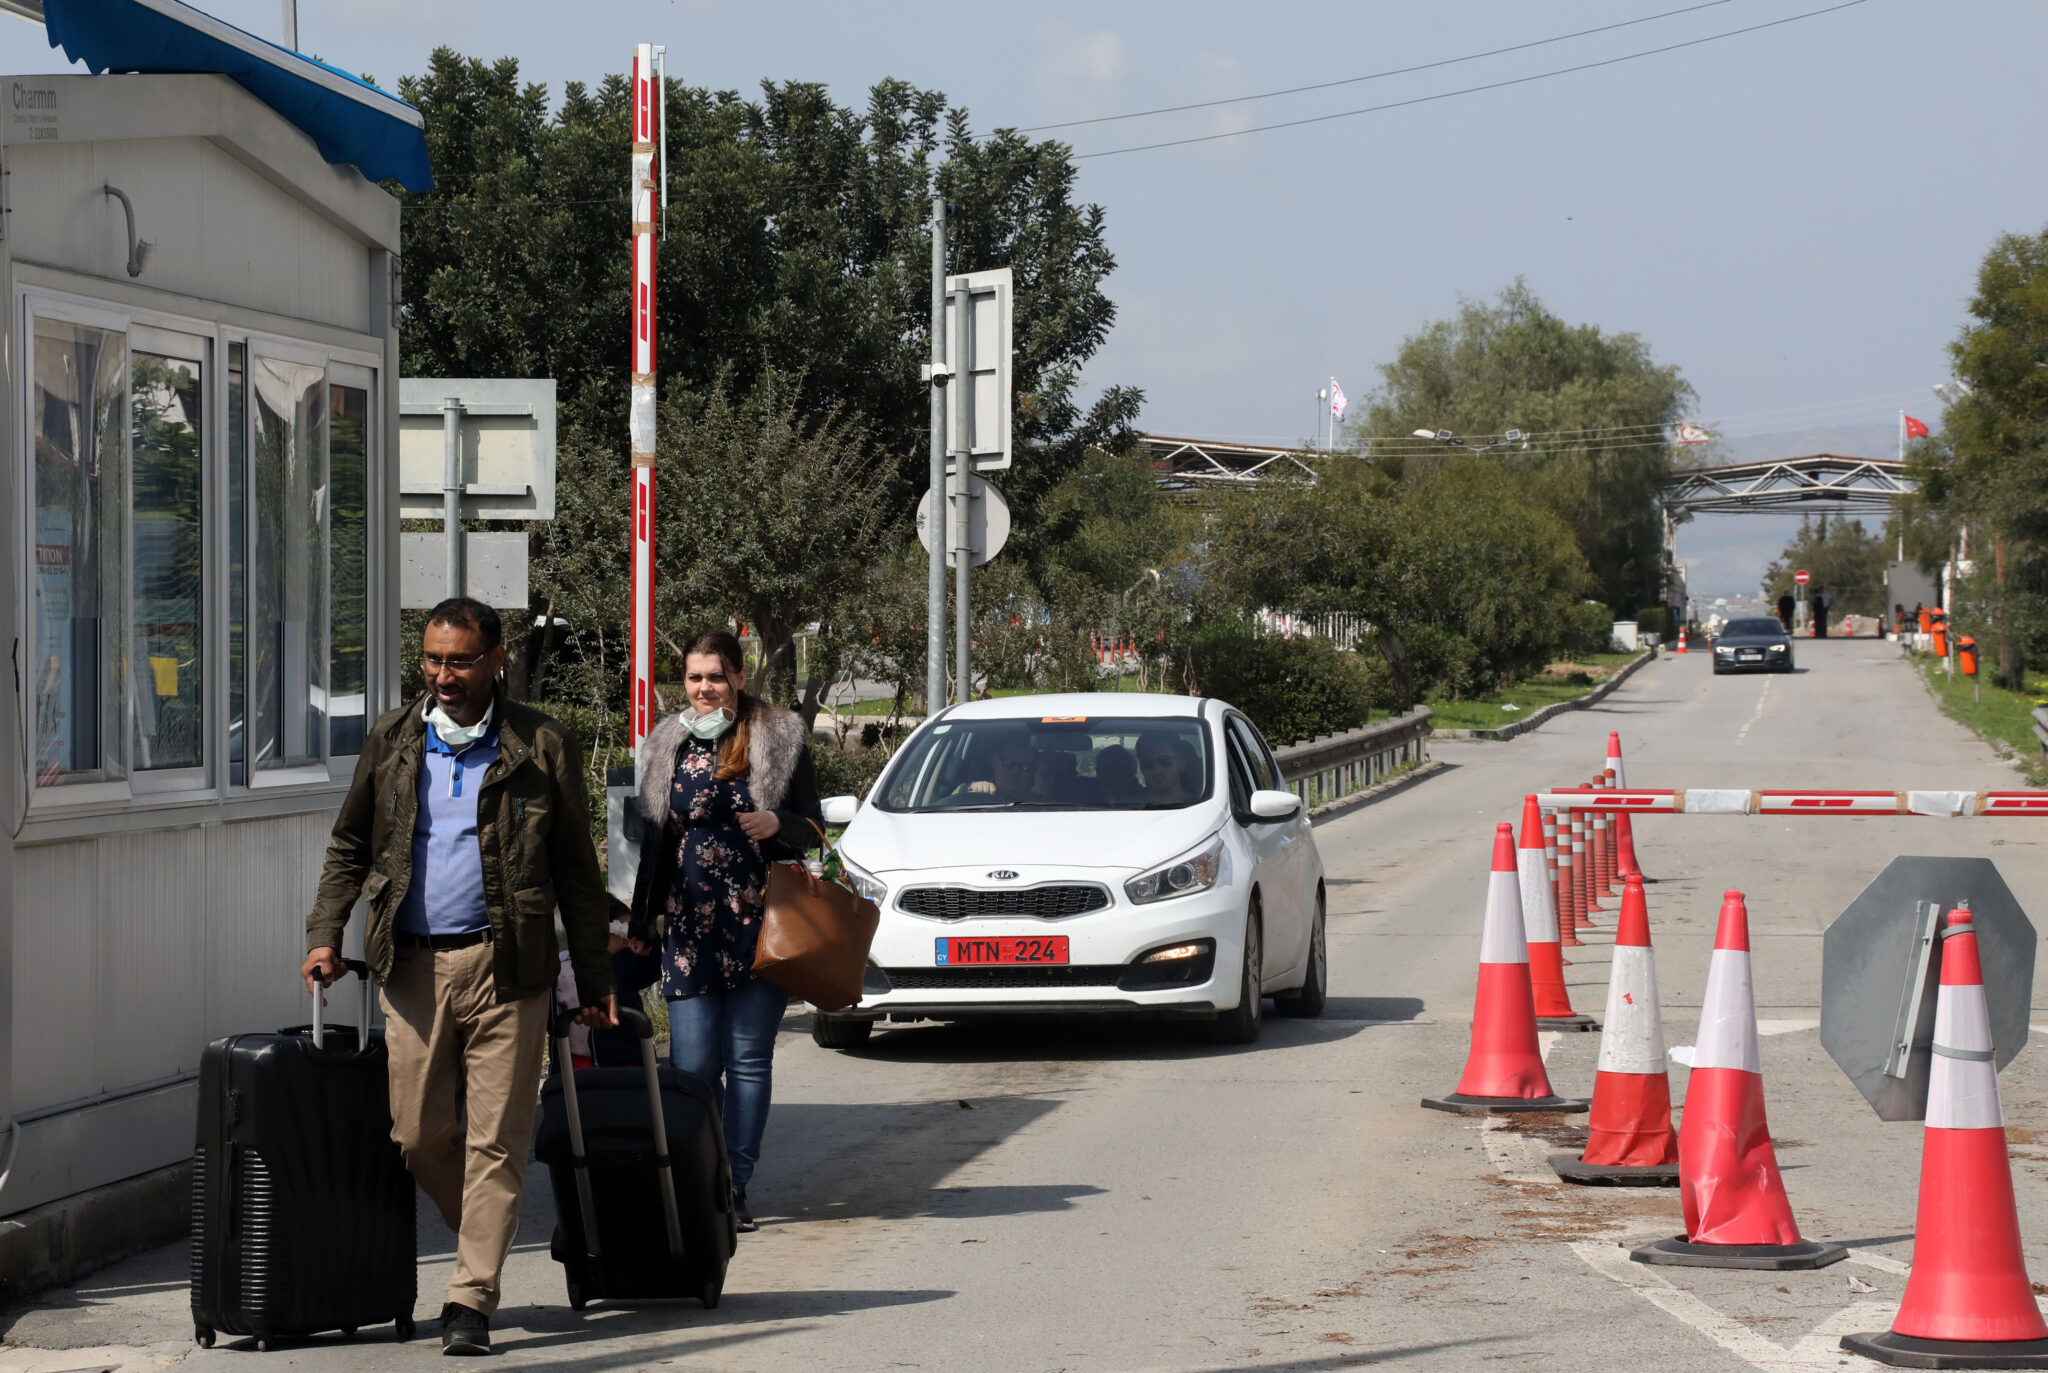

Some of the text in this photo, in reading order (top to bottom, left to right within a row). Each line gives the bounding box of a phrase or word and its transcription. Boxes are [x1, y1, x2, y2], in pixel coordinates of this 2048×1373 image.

[12, 82, 57, 110] Charmm
[957, 941, 1000, 962] MTN
[1015, 940, 1055, 961] 224
